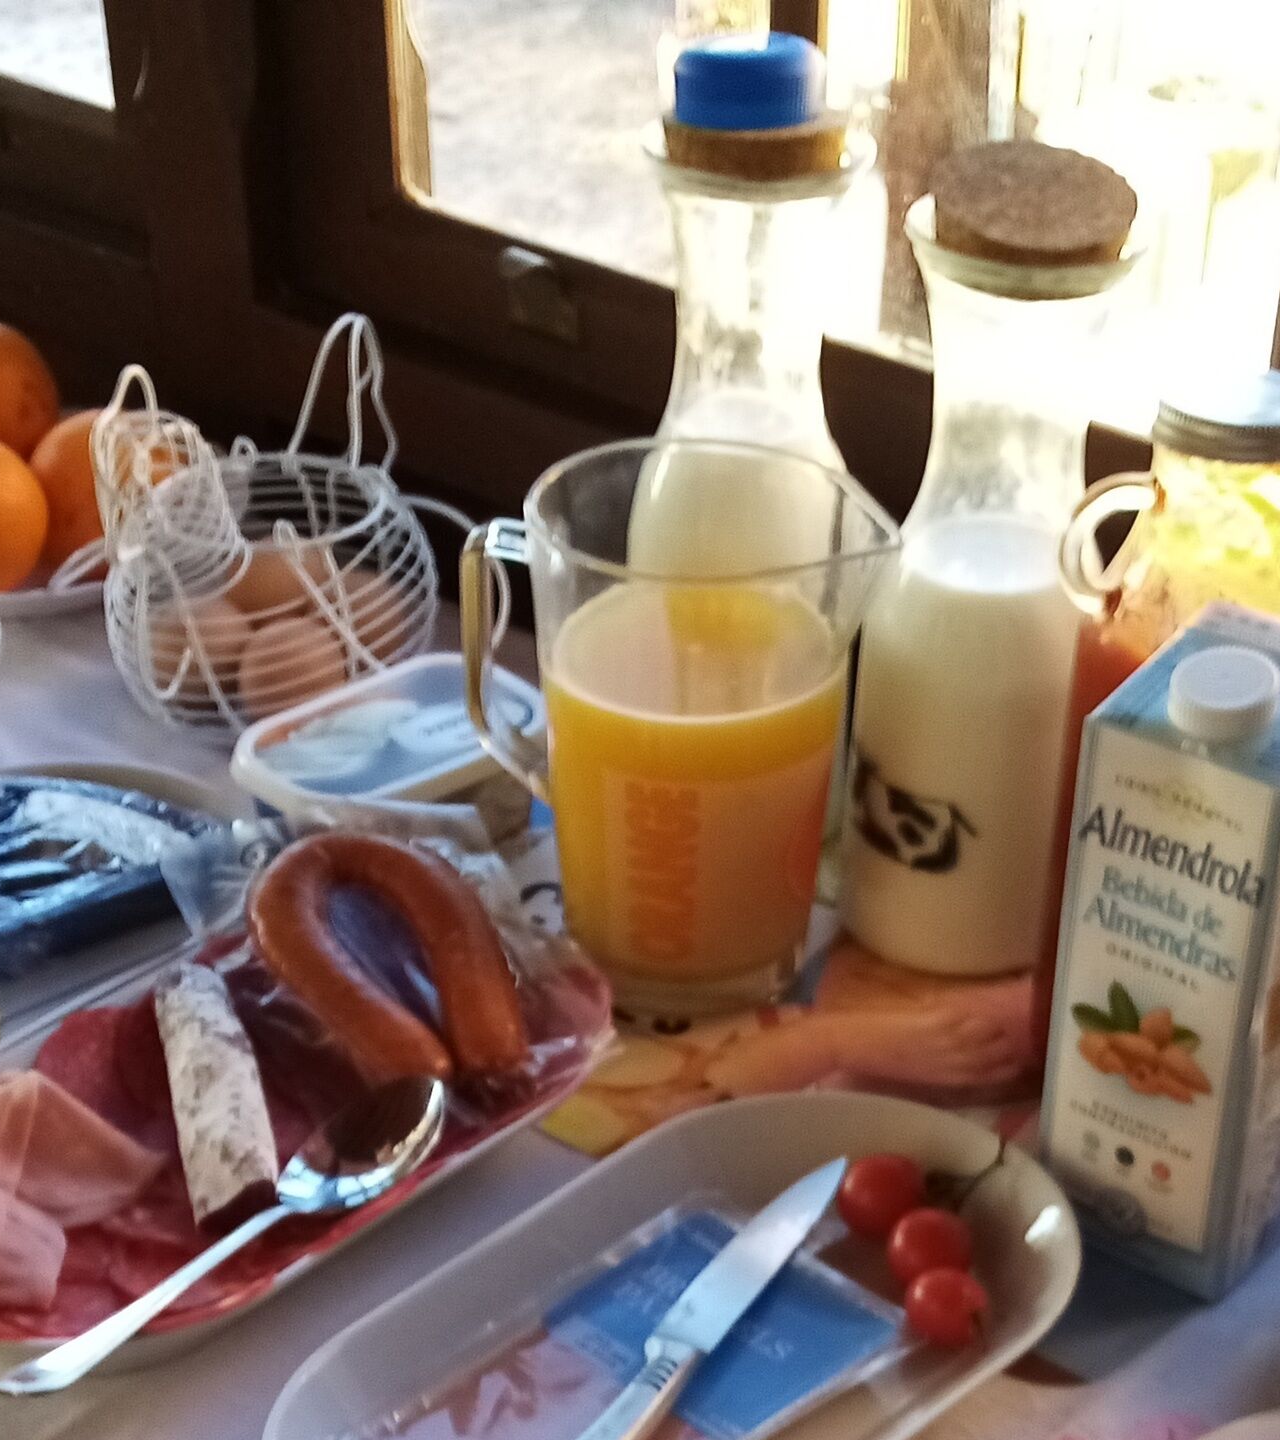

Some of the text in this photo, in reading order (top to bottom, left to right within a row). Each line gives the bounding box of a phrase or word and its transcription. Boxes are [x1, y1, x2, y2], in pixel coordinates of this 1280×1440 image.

[1077, 803, 1267, 909] Almendrola
[1082, 894, 1237, 982] Almendras
[1102, 863, 1223, 938] Bebida de
